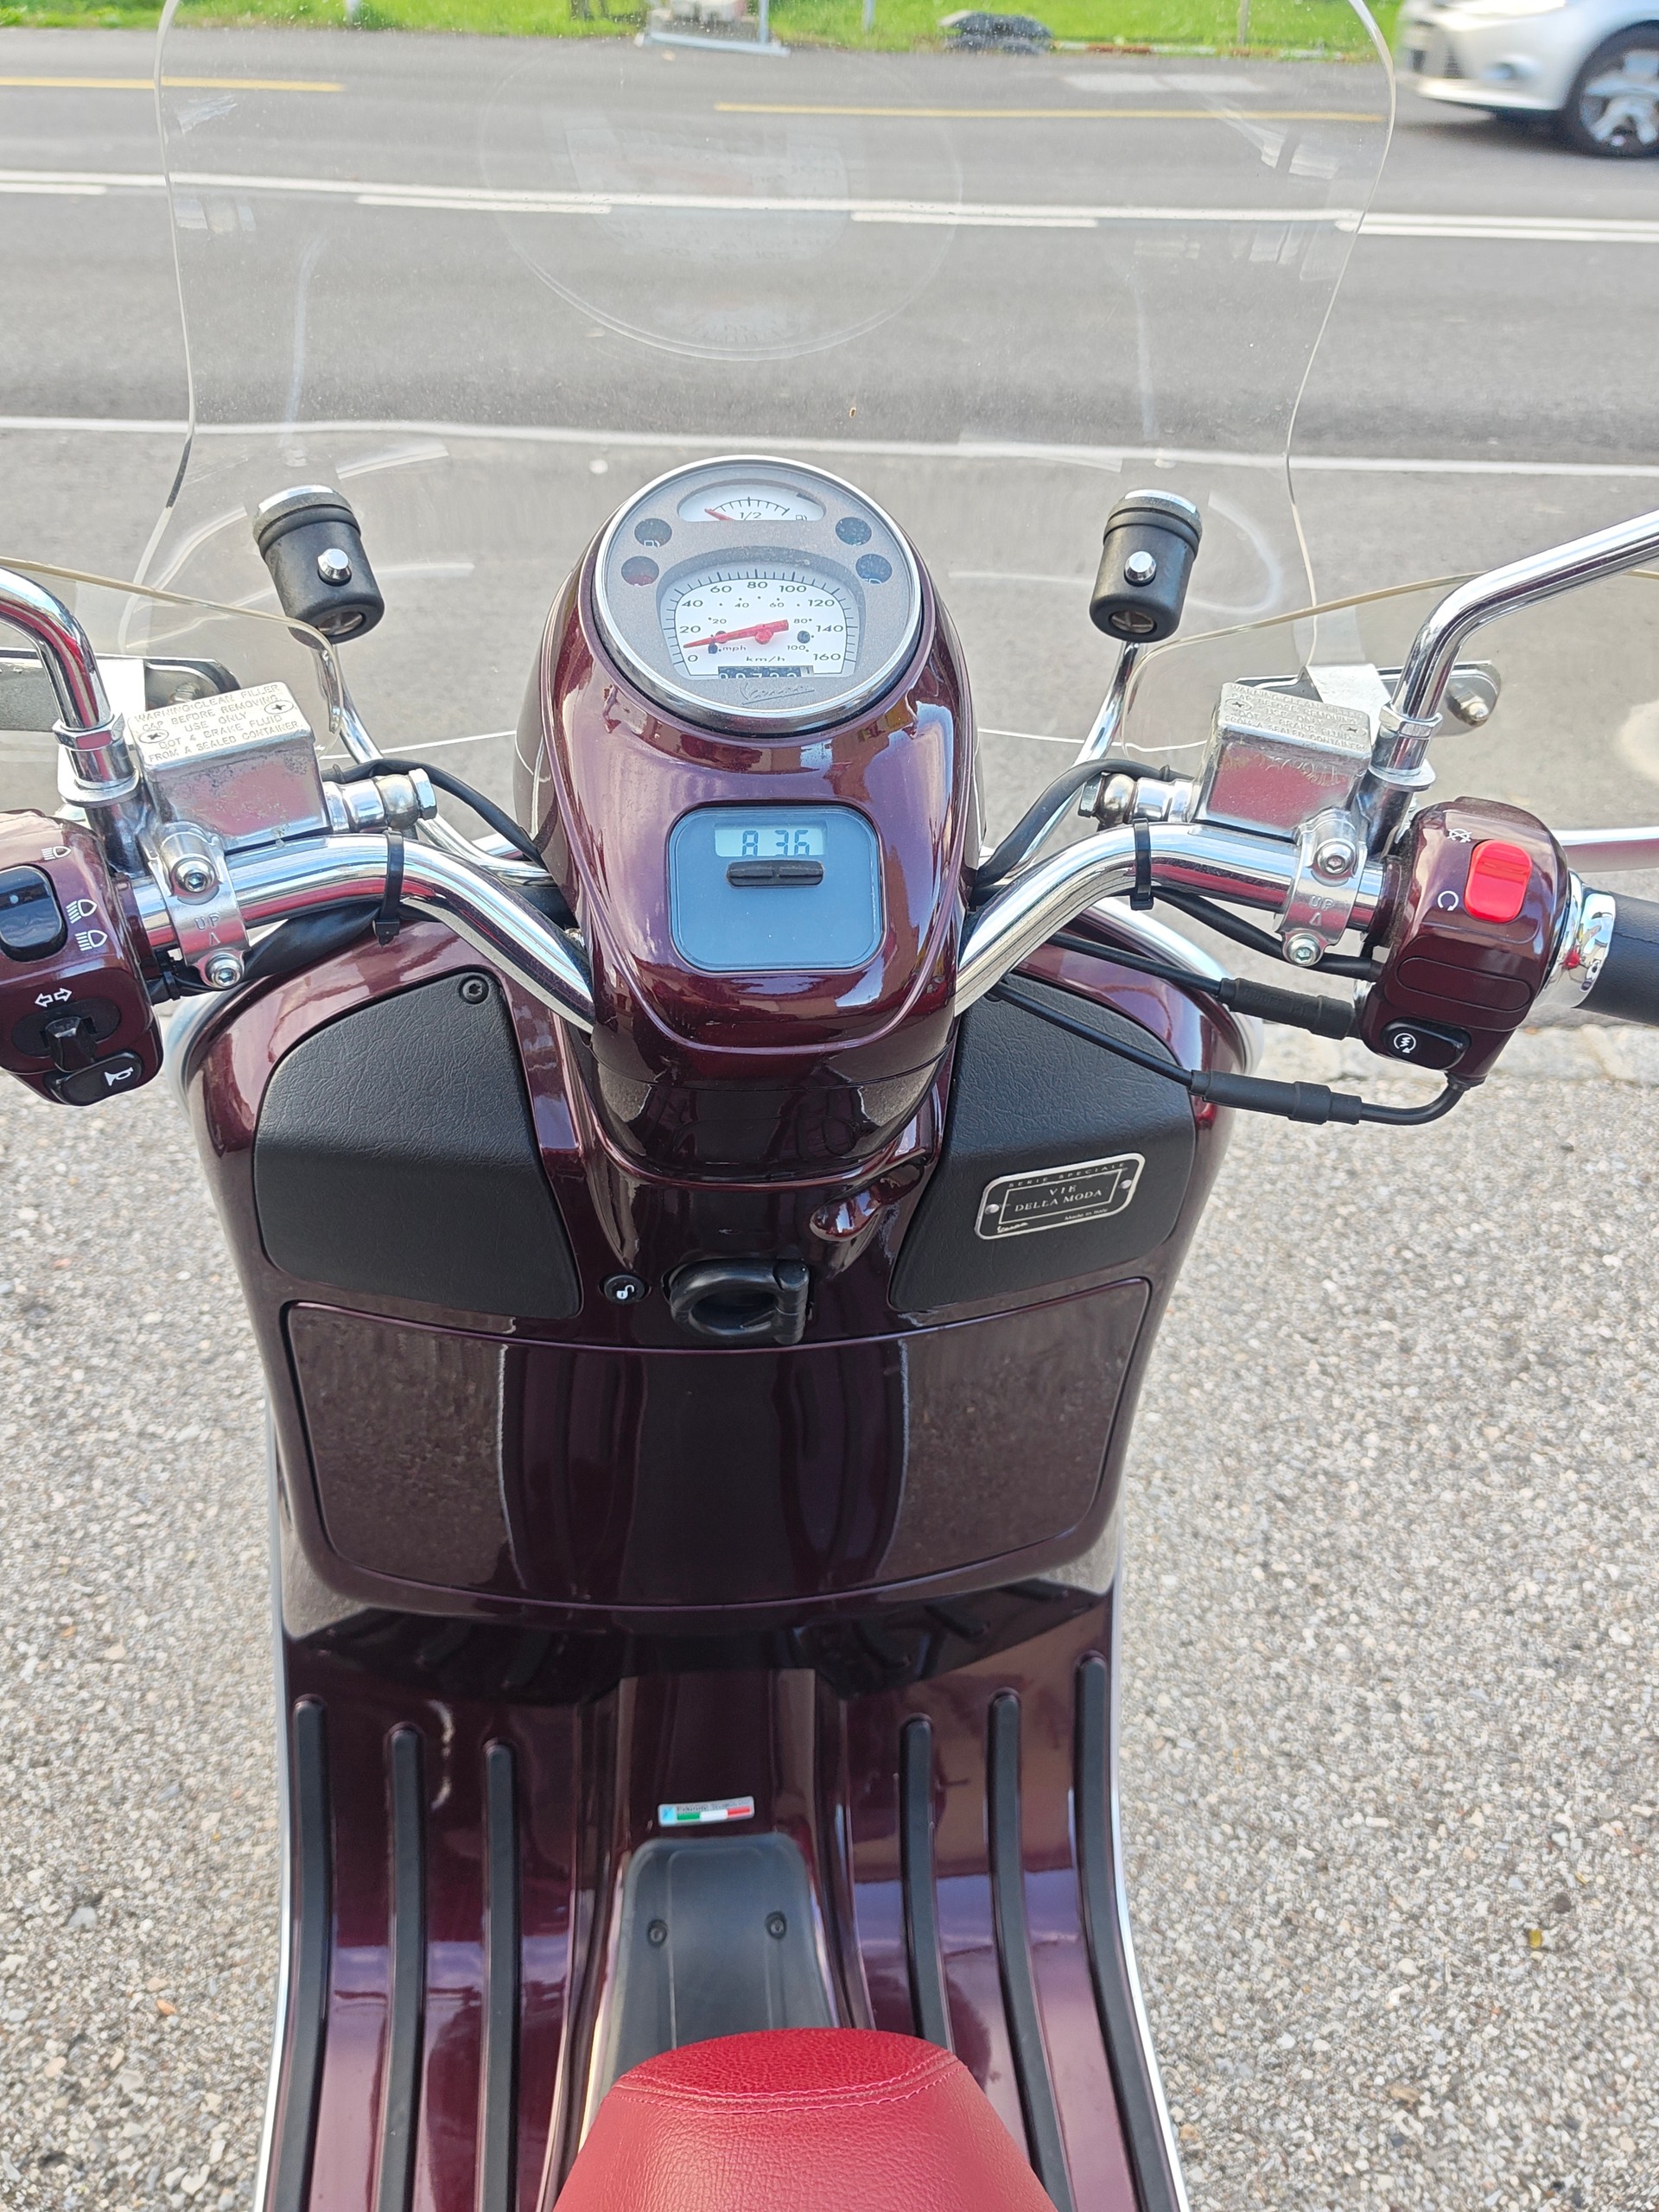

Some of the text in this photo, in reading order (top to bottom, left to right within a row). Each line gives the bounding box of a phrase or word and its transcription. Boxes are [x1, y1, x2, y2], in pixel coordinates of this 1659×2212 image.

[710, 585, 733, 594] 60
[747, 581, 768, 589] 80
[779, 585, 807, 594] 100
[807, 599, 835, 607] 120
[688, 654, 699, 663] 0
[240, 684, 281, 699] FILLER
[143, 721, 164, 732] CAP
[171, 709, 216, 725] BEFORE
[184, 711, 247, 732] USE ONLY
[158, 714, 283, 749] DOT 4 BRAKE FLUID
[149, 749, 180, 762] FROM
[184, 746, 192, 754] A
[197, 735, 237, 751] SEALED
[1309, 893, 1334, 910] UP
[194, 914, 220, 931] UP
[1008, 1162, 1125, 1188] SERIE SPECIALE
[1049, 1185, 1077, 1196] VIE
[1014, 1189, 1103, 1212] DELLA MODA
[1065, 1212, 1084, 1221] Made
